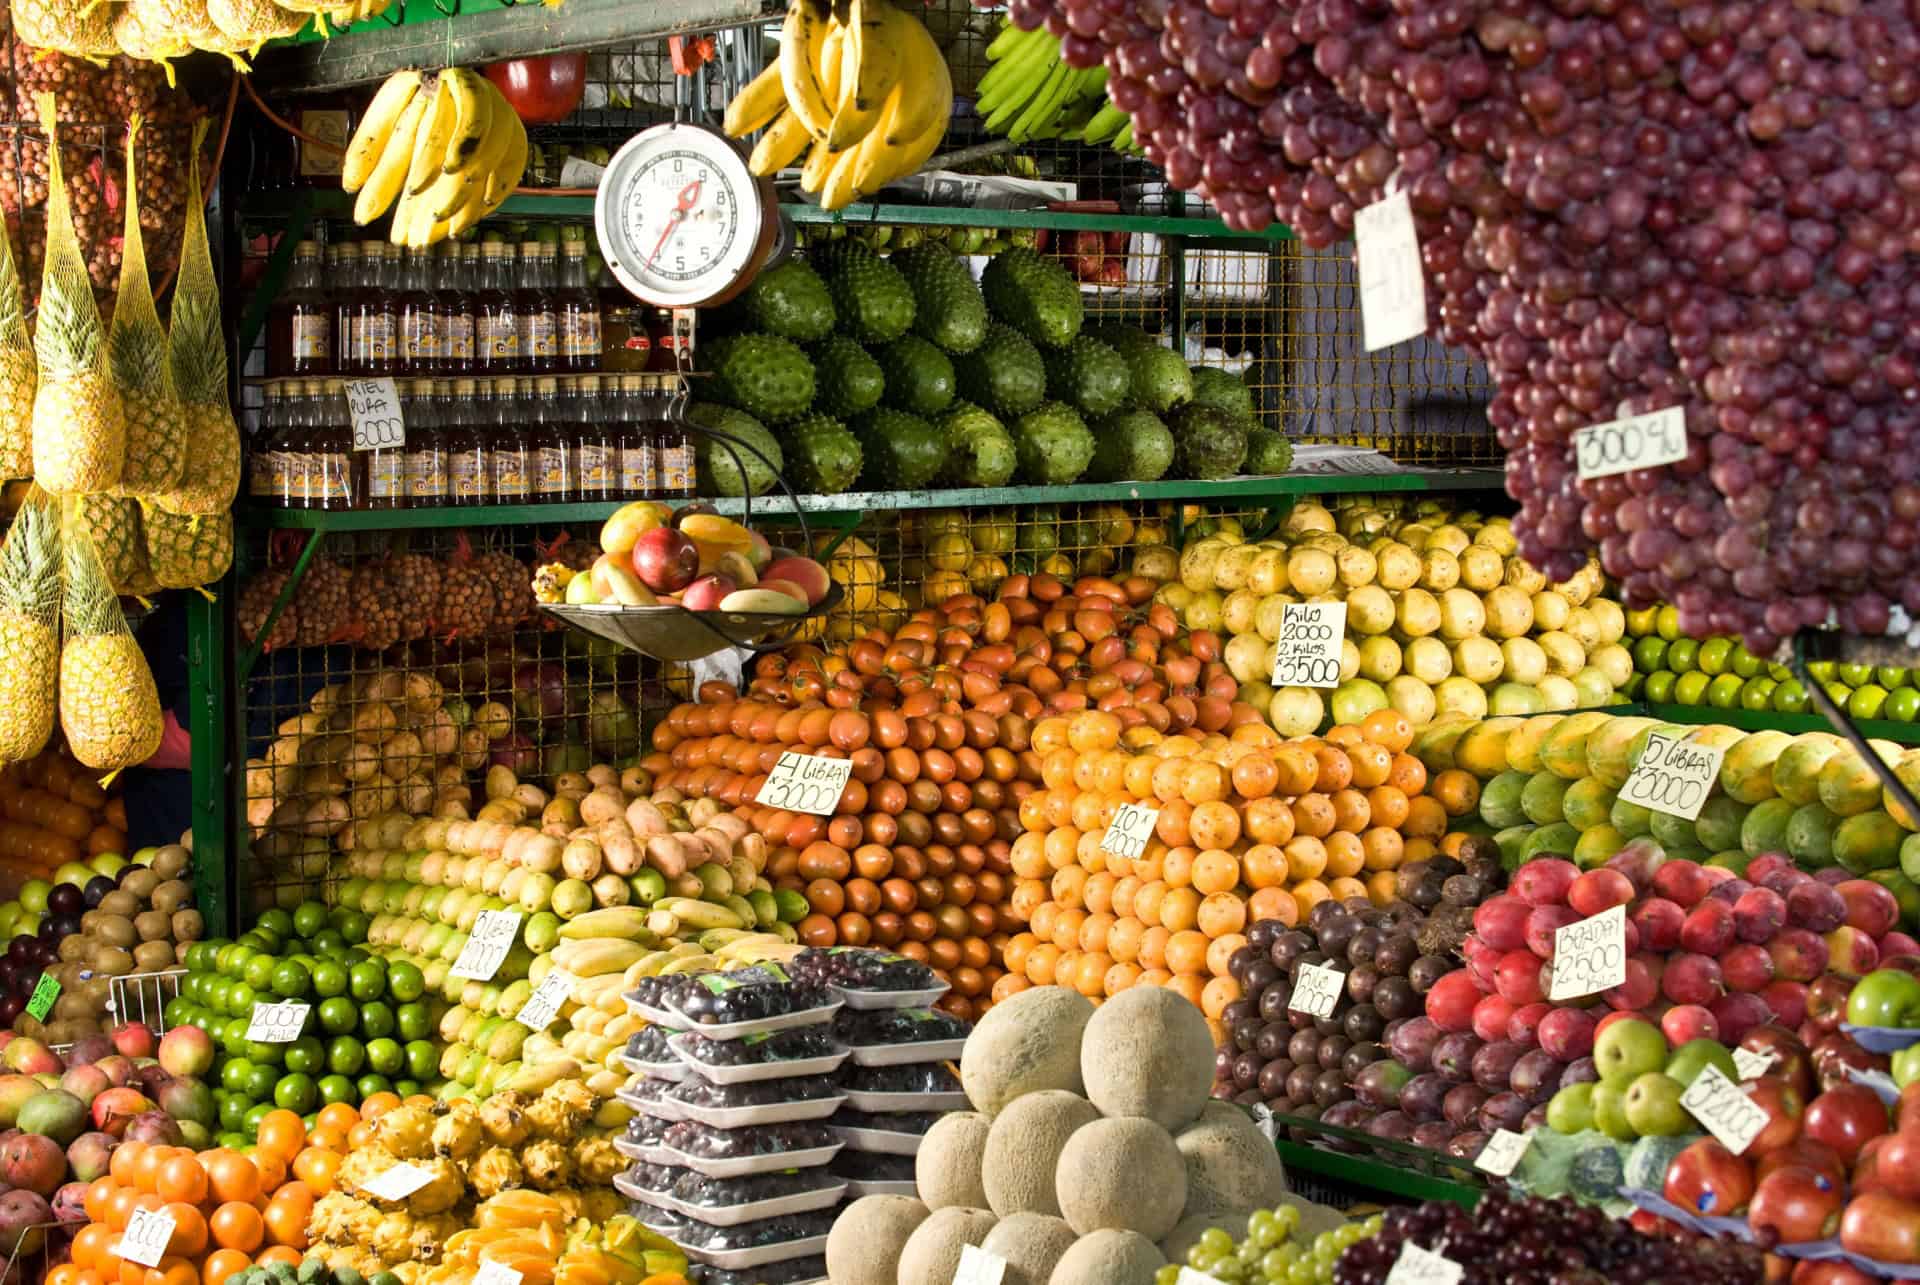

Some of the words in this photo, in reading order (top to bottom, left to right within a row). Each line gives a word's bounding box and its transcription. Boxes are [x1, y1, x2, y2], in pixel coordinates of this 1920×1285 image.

[674, 159, 682, 172] 0
[676, 256, 685, 271] 5
[346, 382, 385, 395] MIEL
[355, 417, 402, 446] 6000
[1281, 623, 1333, 641] 2000
[1278, 642, 1289, 657] 2
[1643, 733, 1671, 764] 5
[777, 753, 802, 777] 4
[1555, 943, 1621, 987] 2500
[250, 1005, 306, 1027] 2000
